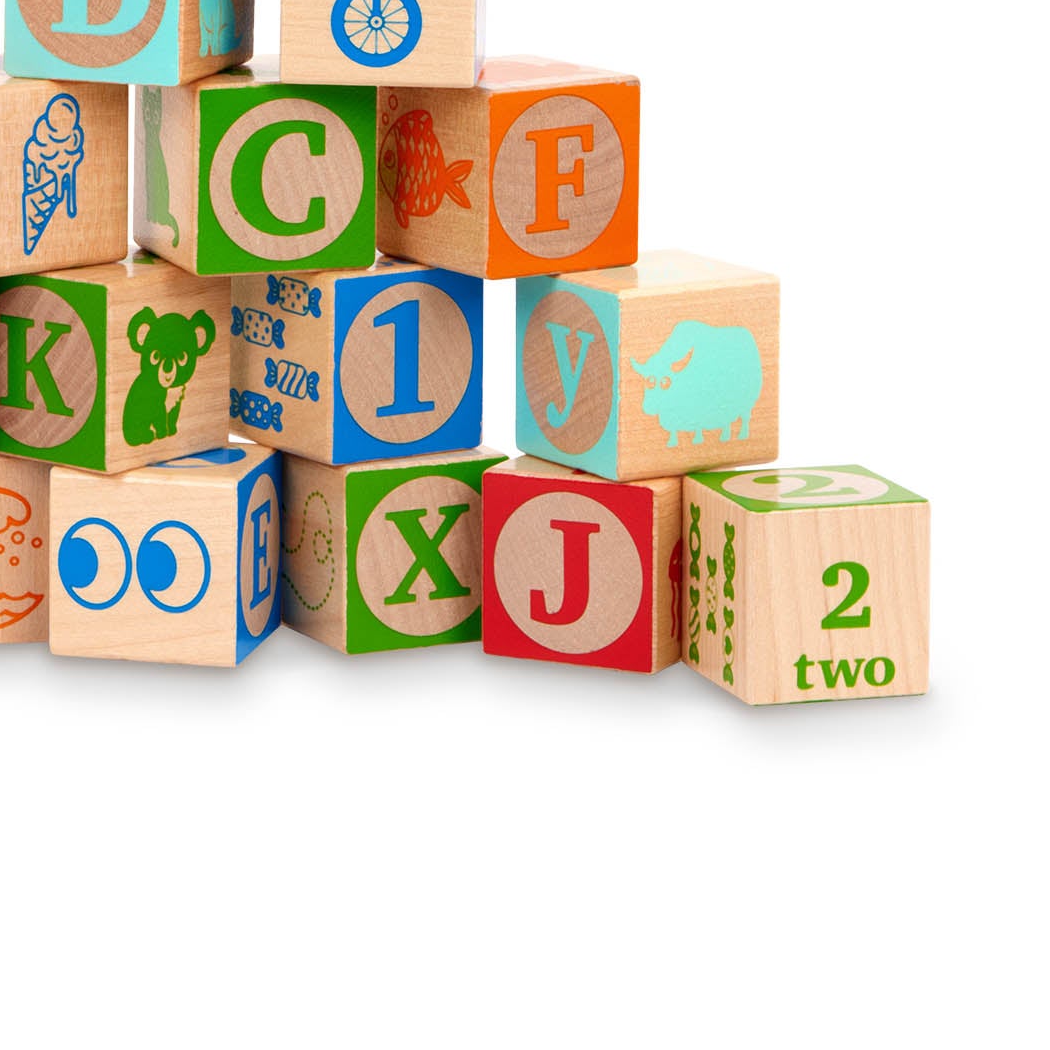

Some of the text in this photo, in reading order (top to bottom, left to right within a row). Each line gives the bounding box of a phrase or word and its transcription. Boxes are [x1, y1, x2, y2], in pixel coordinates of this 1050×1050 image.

[231, 120, 325, 236] C
[526, 124, 594, 234] F
[0, 315, 73, 416] K
[374, 300, 434, 417] 1
[546, 323, 594, 428] y
[753, 475, 860, 498] 2
[250, 501, 270, 609] E
[384, 504, 469, 604] X
[530, 520, 600, 625] J
[821, 562, 870, 628] 2
[795, 655, 894, 689] two
